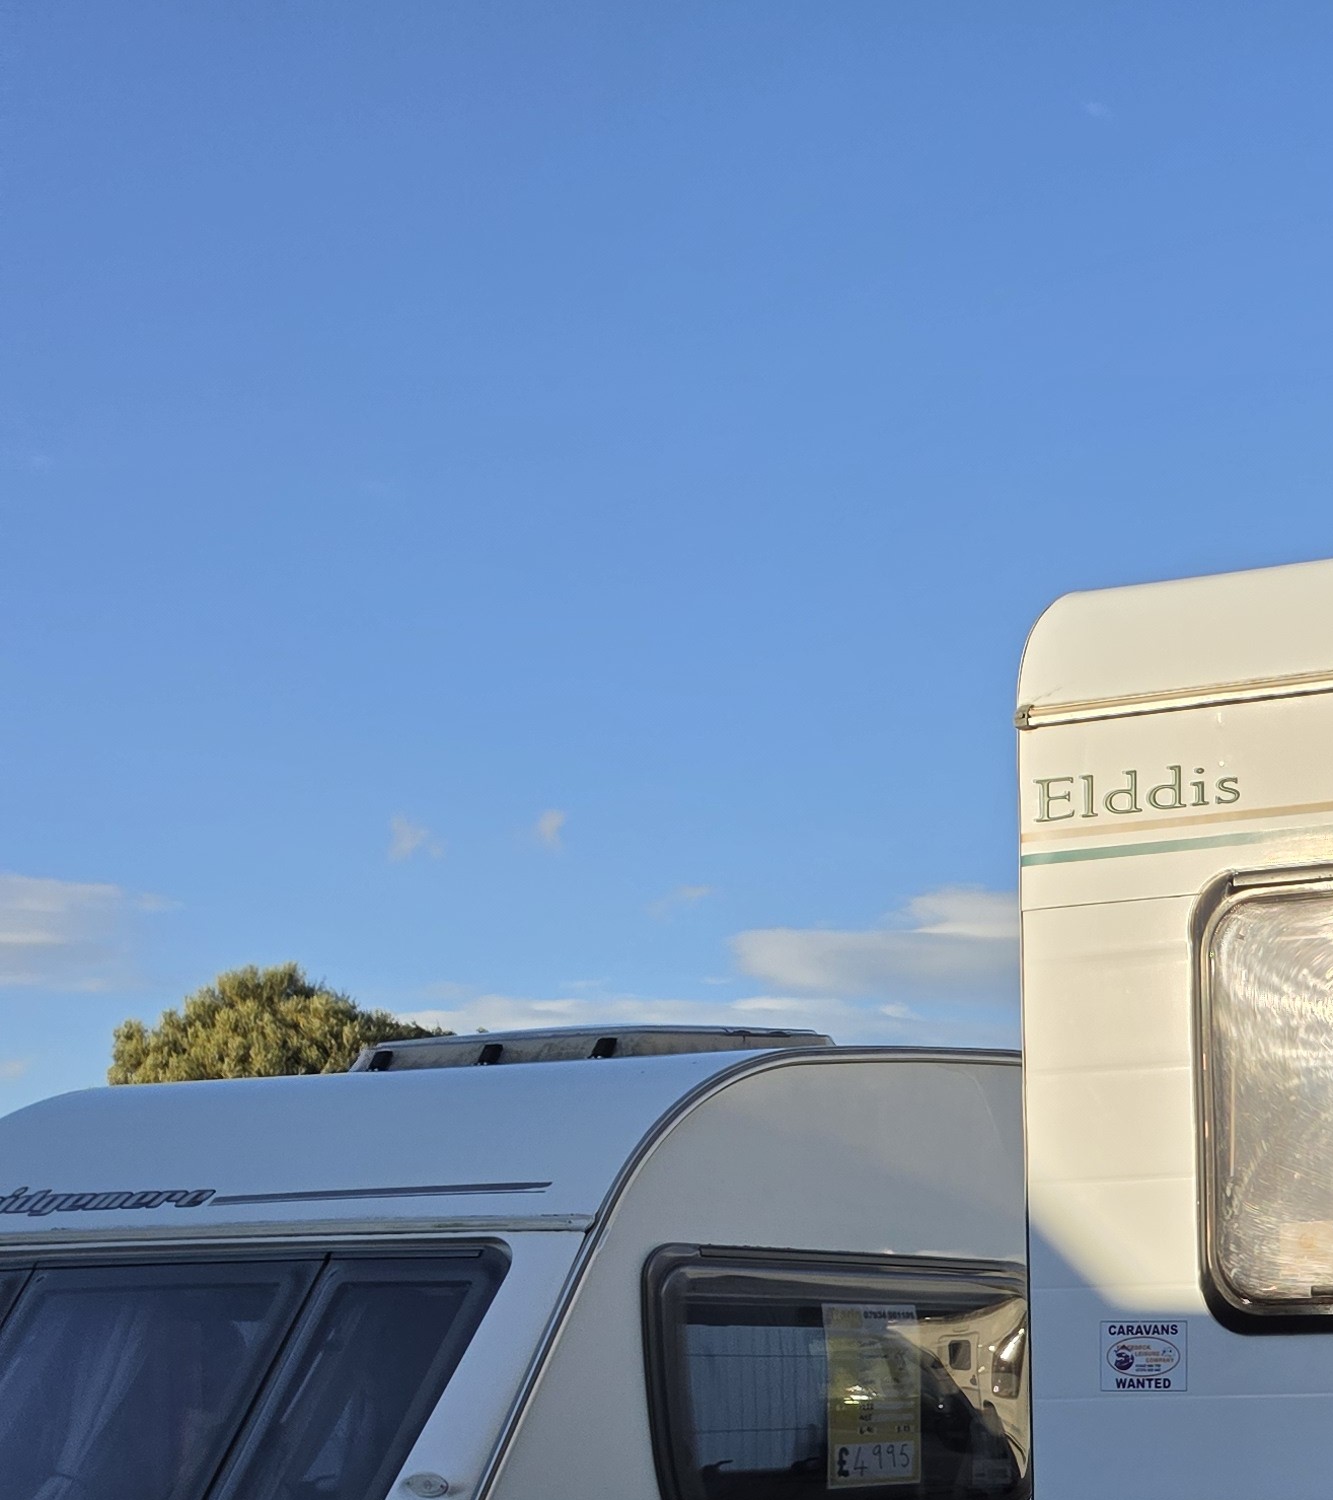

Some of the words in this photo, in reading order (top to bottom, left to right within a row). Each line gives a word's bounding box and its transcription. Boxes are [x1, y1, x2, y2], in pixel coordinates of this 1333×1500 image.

[1033, 765, 1241, 823] Elddis
[0, 1186, 216, 1216] idgemere
[1108, 1325, 1178, 1335] CARAVANS
[1116, 1378, 1171, 1389] WANTED
[837, 1443, 910, 1478] £4995
